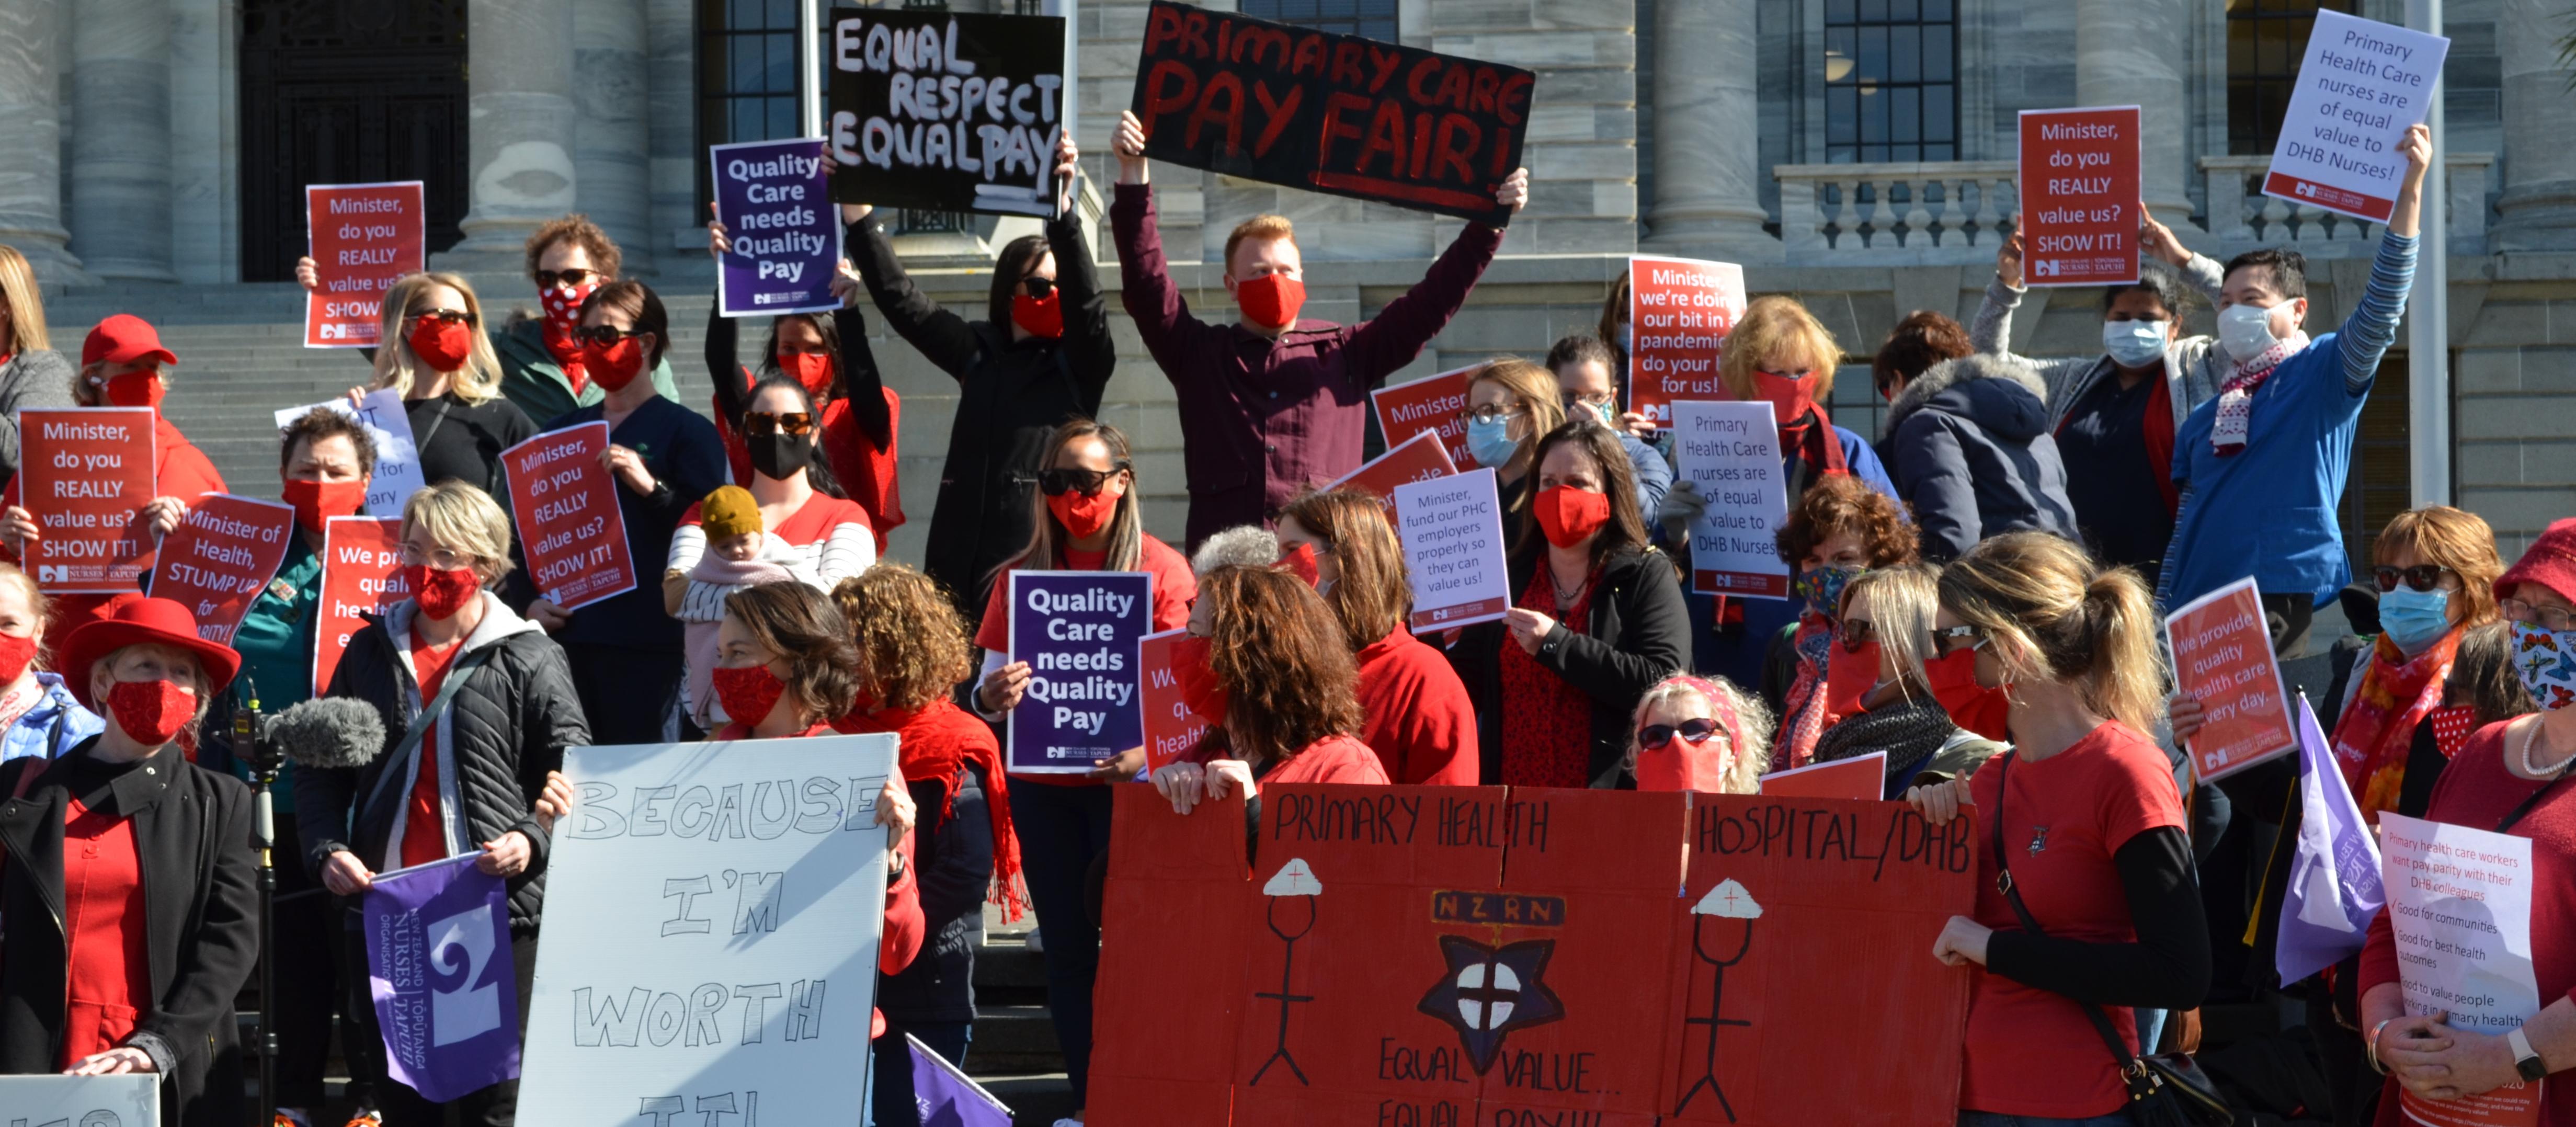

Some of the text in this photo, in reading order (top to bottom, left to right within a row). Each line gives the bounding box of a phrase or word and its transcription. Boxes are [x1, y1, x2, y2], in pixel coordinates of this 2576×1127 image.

[836, 18, 975, 75] EQUAL
[2344, 30, 2413, 62] Primary
[1146, 6, 1534, 127] PRIMARY CARE
[2320, 50, 2421, 87] Health Care
[890, 72, 1062, 126] RESPECT
[2318, 78, 2408, 108] nurses are
[1143, 59, 1511, 195] PAY FAIR!
[2321, 101, 2392, 130] of equal
[2042, 123, 2118, 141] Minister,
[2314, 126, 2382, 153] value to
[728, 153, 820, 182] Quality
[2049, 150, 2110, 169] do you
[2287, 142, 2395, 181] DHB Nurses!
[747, 184, 804, 203] Care
[2049, 178, 2111, 195] REALLY
[330, 198, 403, 214] Minister,
[741, 206, 816, 230] needs
[2038, 205, 2121, 224] value us?
[339, 223, 395, 241] do you
[2038, 234, 2121, 252] SHOW IT!
[339, 248, 397, 266] REALLY
[734, 231, 826, 259] Quality
[329, 276, 372, 292] value
[759, 260, 804, 283] Pay
[326, 301, 380, 317] SHOW
[1640, 290, 1688, 306] we're
[1644, 311, 1723, 327] our bit in
[1643, 355, 1665, 371] do
[1670, 359, 1710, 374] your
[1662, 376, 1718, 393] for us!
[43, 423, 130, 442] Minister,
[1695, 416, 1748, 435] Primary
[520, 440, 587, 474] Minister,
[1686, 440, 1767, 456] Health Care
[54, 450, 121, 472] do you
[381, 463, 405, 477] for
[531, 467, 582, 497] do you
[1693, 468, 1766, 480] nurses are
[54, 481, 123, 498] REALLY
[1418, 490, 1471, 508] Minister,
[1705, 488, 1761, 507] of equal
[43, 509, 135, 528] value us?
[534, 491, 587, 525] REALLY
[1407, 502, 1488, 528] fund our PHC
[182, 507, 282, 543] Minister of
[1418, 523, 1480, 543] employers
[1709, 514, 1764, 529] value to
[43, 540, 136, 557] SHOW IT!
[533, 517, 604, 556] value us?
[1698, 536, 1727, 551] DHB
[194, 538, 255, 570] Health,
[339, 547, 372, 564] We
[1417, 538, 1485, 563] properly so
[537, 544, 612, 586] SHOW IT!
[1428, 558, 1479, 575] they can
[168, 563, 236, 592] STUMP
[237, 578, 259, 594] UP
[1428, 573, 1482, 593] value us!
[197, 599, 217, 616] for
[1028, 588, 1134, 618] Quality
[1047, 618, 1114, 641] Care
[2177, 613, 2254, 656] We provide
[1038, 647, 1123, 670] needs
[2194, 643, 2243, 674] quality
[2235, 662, 2265, 684] care
[1027, 676, 1134, 706] Quality
[2239, 690, 2269, 712] day.
[1054, 707, 1107, 735] Pay
[566, 775, 888, 839] BECAUSE
[1275, 793, 1548, 852] PRIMARY HEALTH
[2389, 833, 2518, 868] Primary health care workers
[2392, 855, 2512, 886] want pay parity with their
[2411, 876, 2484, 901] DHB colleagues
[661, 869, 783, 937] I'M
[1438, 896, 1552, 922] NZRN
[411, 907, 420, 934] NEW
[2398, 903, 2497, 934] Good for communities
[2398, 930, 2486, 960] Good for best health
[413, 937, 424, 987] ZEALAND
[2399, 950, 2437, 968] outcomes
[394, 912, 413, 1065] NURSES TAPUHI
[2420, 983, 2494, 1008] to value people
[572, 980, 826, 1048] WORTH
[2430, 1004, 2523, 1027] in health
[1378, 1038, 1468, 1083] EQUAL
